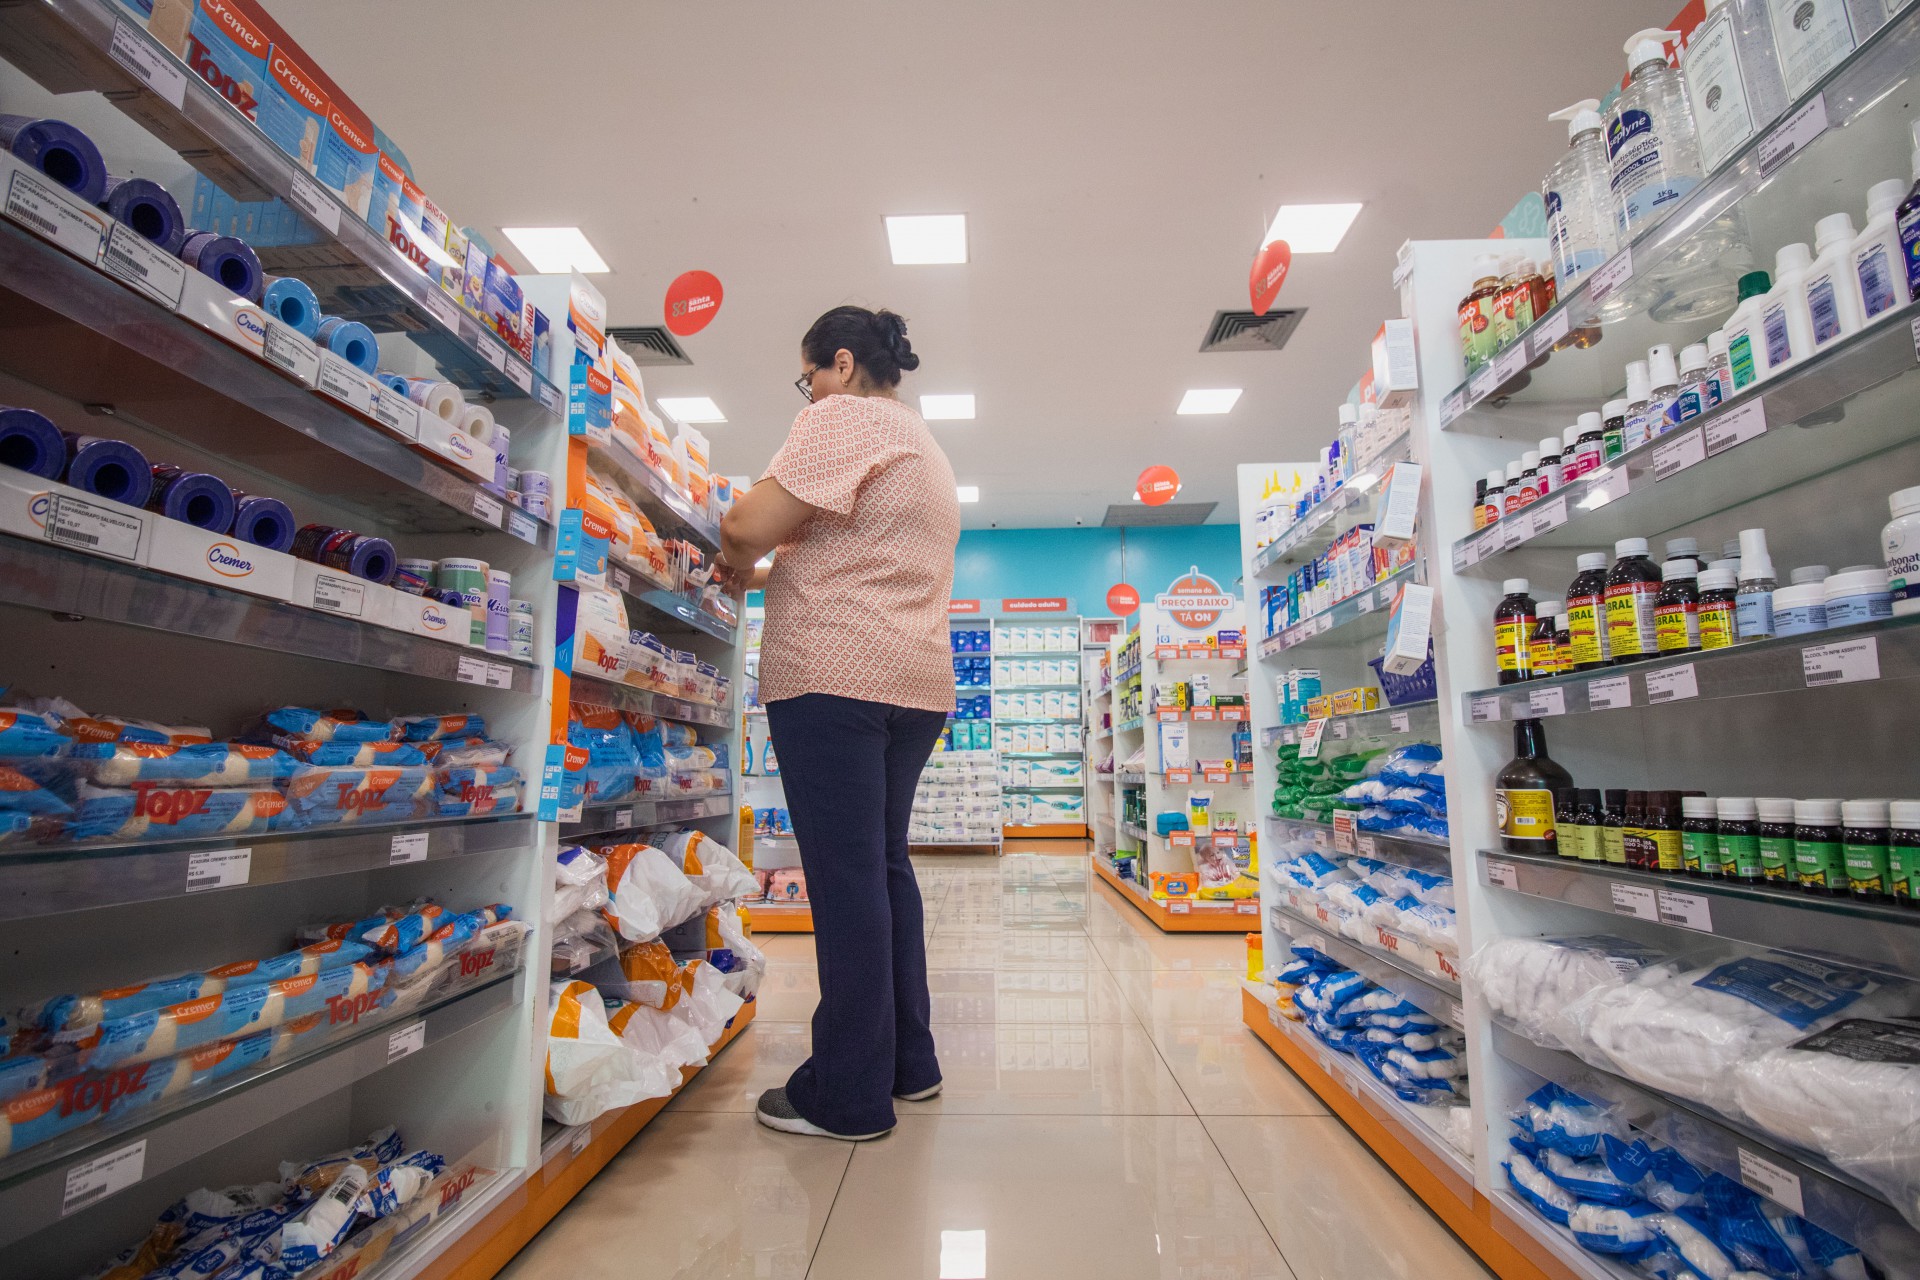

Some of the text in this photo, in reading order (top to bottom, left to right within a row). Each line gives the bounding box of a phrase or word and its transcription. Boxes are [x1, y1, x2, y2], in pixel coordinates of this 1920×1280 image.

[206, 0, 261, 48] Cremer
[188, 32, 258, 122] Topz
[274, 58, 323, 108] Cremer
[332, 113, 367, 149] Cremer
[1613, 136, 1659, 168] Antisséptico
[15, 180, 83, 223] ESPARADRAPO CREMER
[387, 214, 430, 273] Topz
[688, 295, 711, 306] santa
[688, 300, 715, 314] branca
[236, 313, 266, 339] Crem
[588, 372, 609, 392] Cremer
[450, 436, 473, 457] Cremer
[648, 442, 662, 468] Topz
[60, 505, 100, 520] ESPARADRAPO
[584, 517, 608, 536] Cremer
[208, 547, 253, 572] Cremer
[649, 550, 665, 574] Topz
[1893, 563, 1919, 575] Sódio
[1612, 586, 1639, 595] SOBRAL
[1894, 591, 1908, 599] 100g
[1161, 598, 1229, 608] PREÇO BAIXO
[1575, 597, 1601, 606] SOBRAL
[1662, 605, 1687, 614] SOBRAL
[1706, 603, 1731, 611] SOBRAL
[422, 610, 447, 625] Cremer
[1180, 611, 1212, 622] TÁ ON
[597, 647, 620, 673] Topz
[650, 665, 667, 686] Topz
[78, 724, 116, 741] Cremer
[446, 720, 464, 728] Cremer
[566, 752, 586, 765] Cremer
[1225, 761, 1232, 769] G
[371, 776, 395, 785] Cremer
[634, 775, 652, 795] Topz
[679, 776, 692, 792] Topz
[130, 781, 213, 825] Topz
[257, 799, 286, 809] Cremer
[336, 783, 387, 816] Topz
[460, 780, 495, 808] Topz
[1315, 903, 1329, 922] Topz
[1377, 927, 1399, 951] Topz
[459, 949, 496, 977] Topz
[1435, 950, 1460, 982] Top
[282, 977, 313, 991] Cremer
[176, 999, 216, 1018] Cremer
[326, 990, 382, 1025] Topz
[194, 1043, 231, 1062] Cremer
[55, 1061, 150, 1118] Topz
[9, 1090, 58, 1115] Cremer
[440, 1167, 477, 1207] Topz
